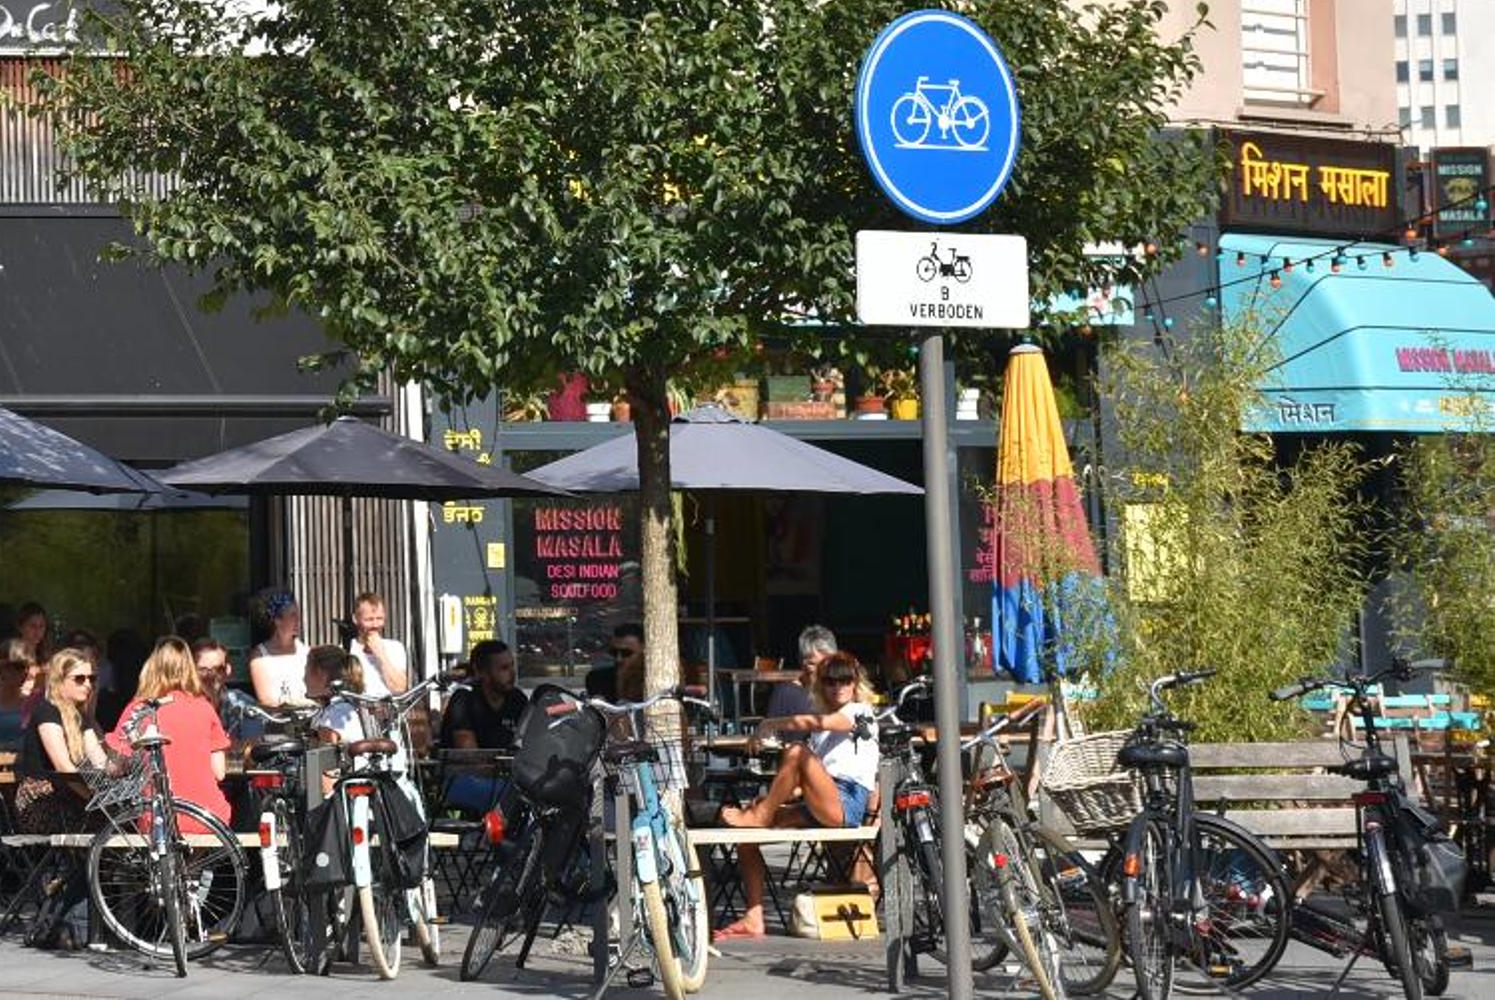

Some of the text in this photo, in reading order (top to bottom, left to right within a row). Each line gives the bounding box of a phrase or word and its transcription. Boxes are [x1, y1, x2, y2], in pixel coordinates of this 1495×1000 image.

[1241, 141, 1390, 208] मिशन मसाला
[1437, 164, 1482, 176] MISSION
[910, 303, 984, 320] VERBODEN
[535, 507, 621, 531] MISSION
[536, 535, 623, 558] MASALA
[547, 564, 618, 578] DESI INDIAN
